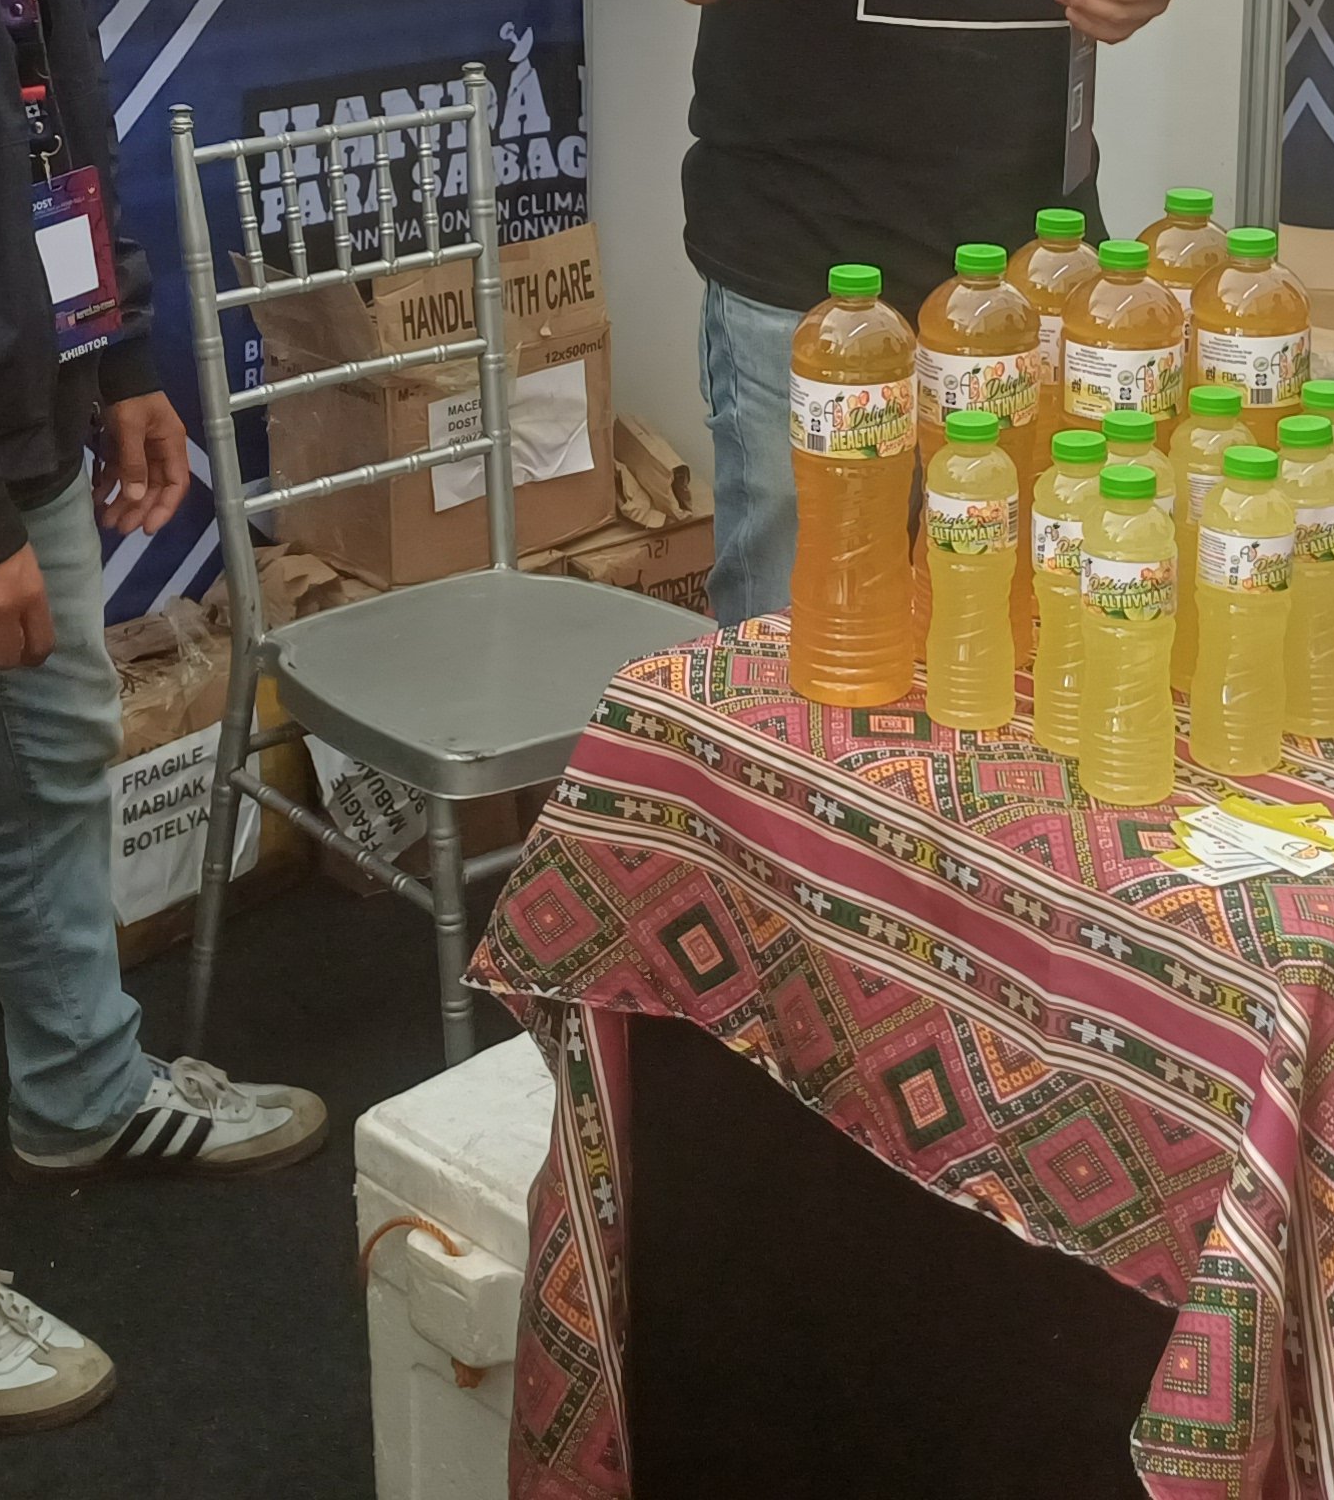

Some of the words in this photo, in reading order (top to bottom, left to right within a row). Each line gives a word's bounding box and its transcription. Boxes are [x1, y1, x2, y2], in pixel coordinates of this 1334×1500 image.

[489, 134, 587, 191] BAG
[516, 192, 586, 216] CLIMA
[399, 289, 477, 343] HANDL
[544, 258, 595, 312] CARE
[544, 338, 603, 365] 12x500mL
[984, 368, 1032, 396] Delight
[447, 416, 478, 433] DOST
[848, 398, 900, 428] Delight
[1088, 574, 1149, 594] Delight
[121, 745, 205, 795] FRAGILE
[122, 776, 207, 827] MABUAK
[329, 771, 384, 853] FRAGILE
[122, 806, 211, 858] BOTELYA
